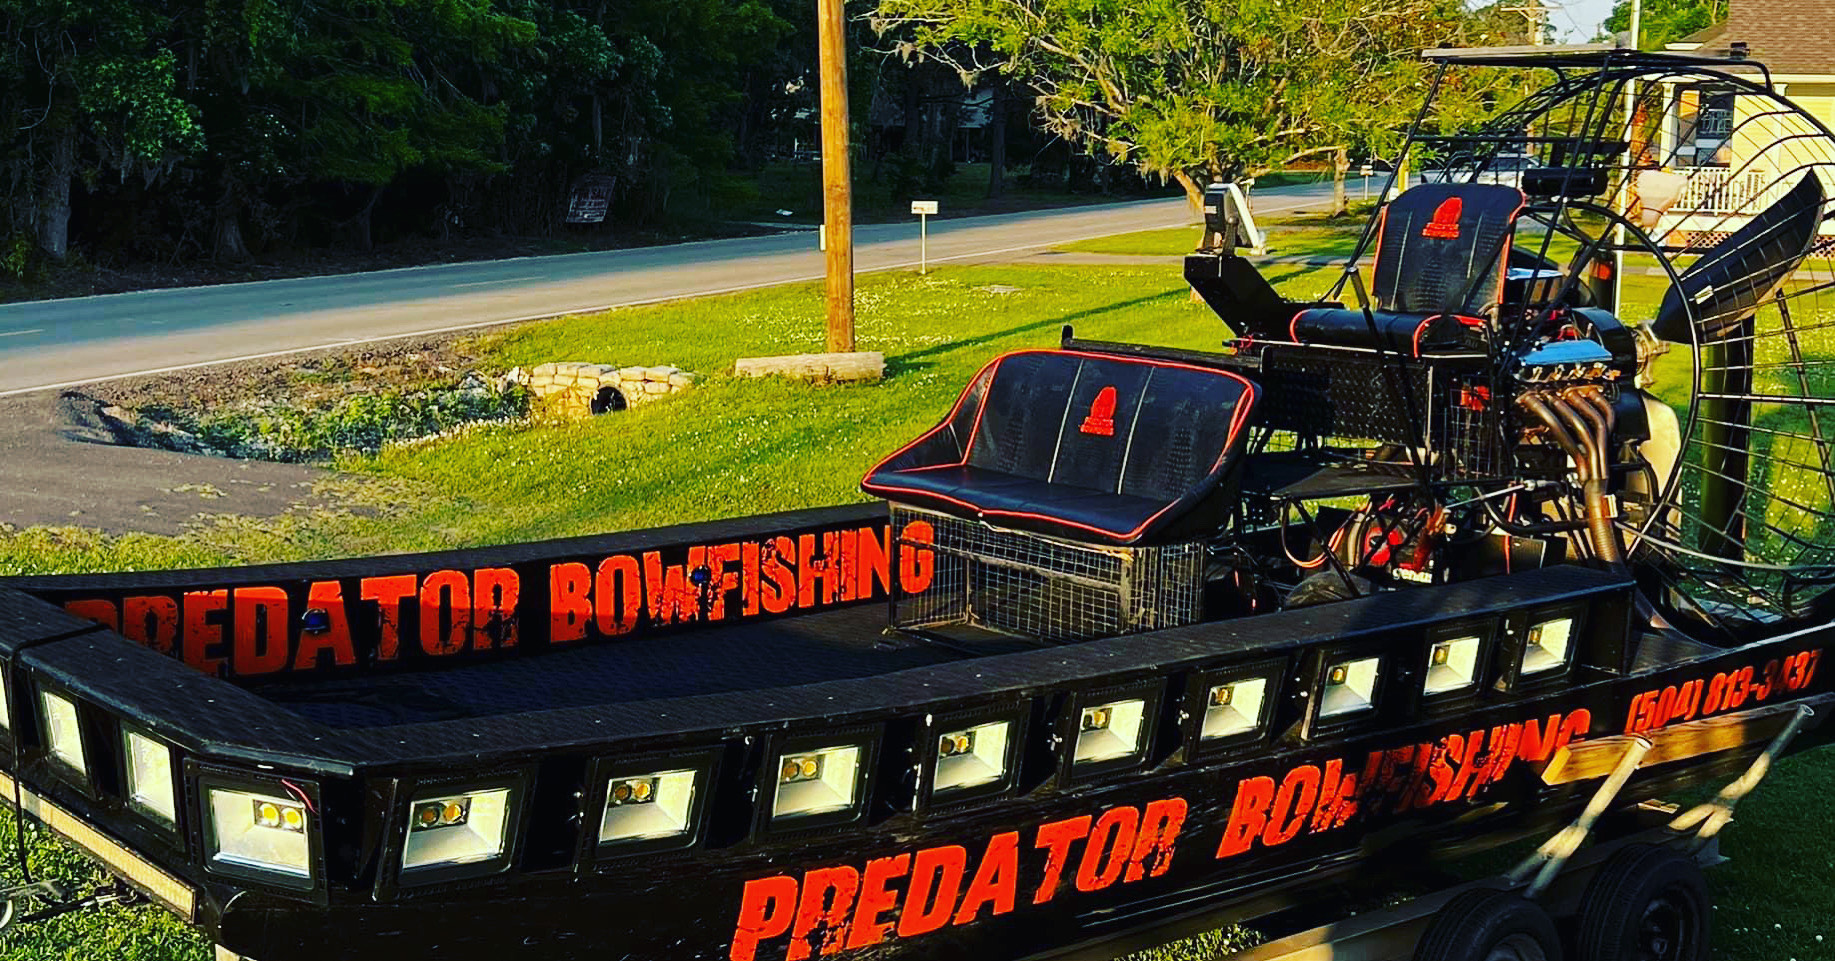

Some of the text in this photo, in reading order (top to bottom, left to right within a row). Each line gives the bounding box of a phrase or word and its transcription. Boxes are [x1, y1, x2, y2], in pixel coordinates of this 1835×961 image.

[550, 520, 934, 643] BOWFISHING
[1625, 648, 1822, 734] (504) 813-3437
[729, 797, 1188, 961] PREDATOR
